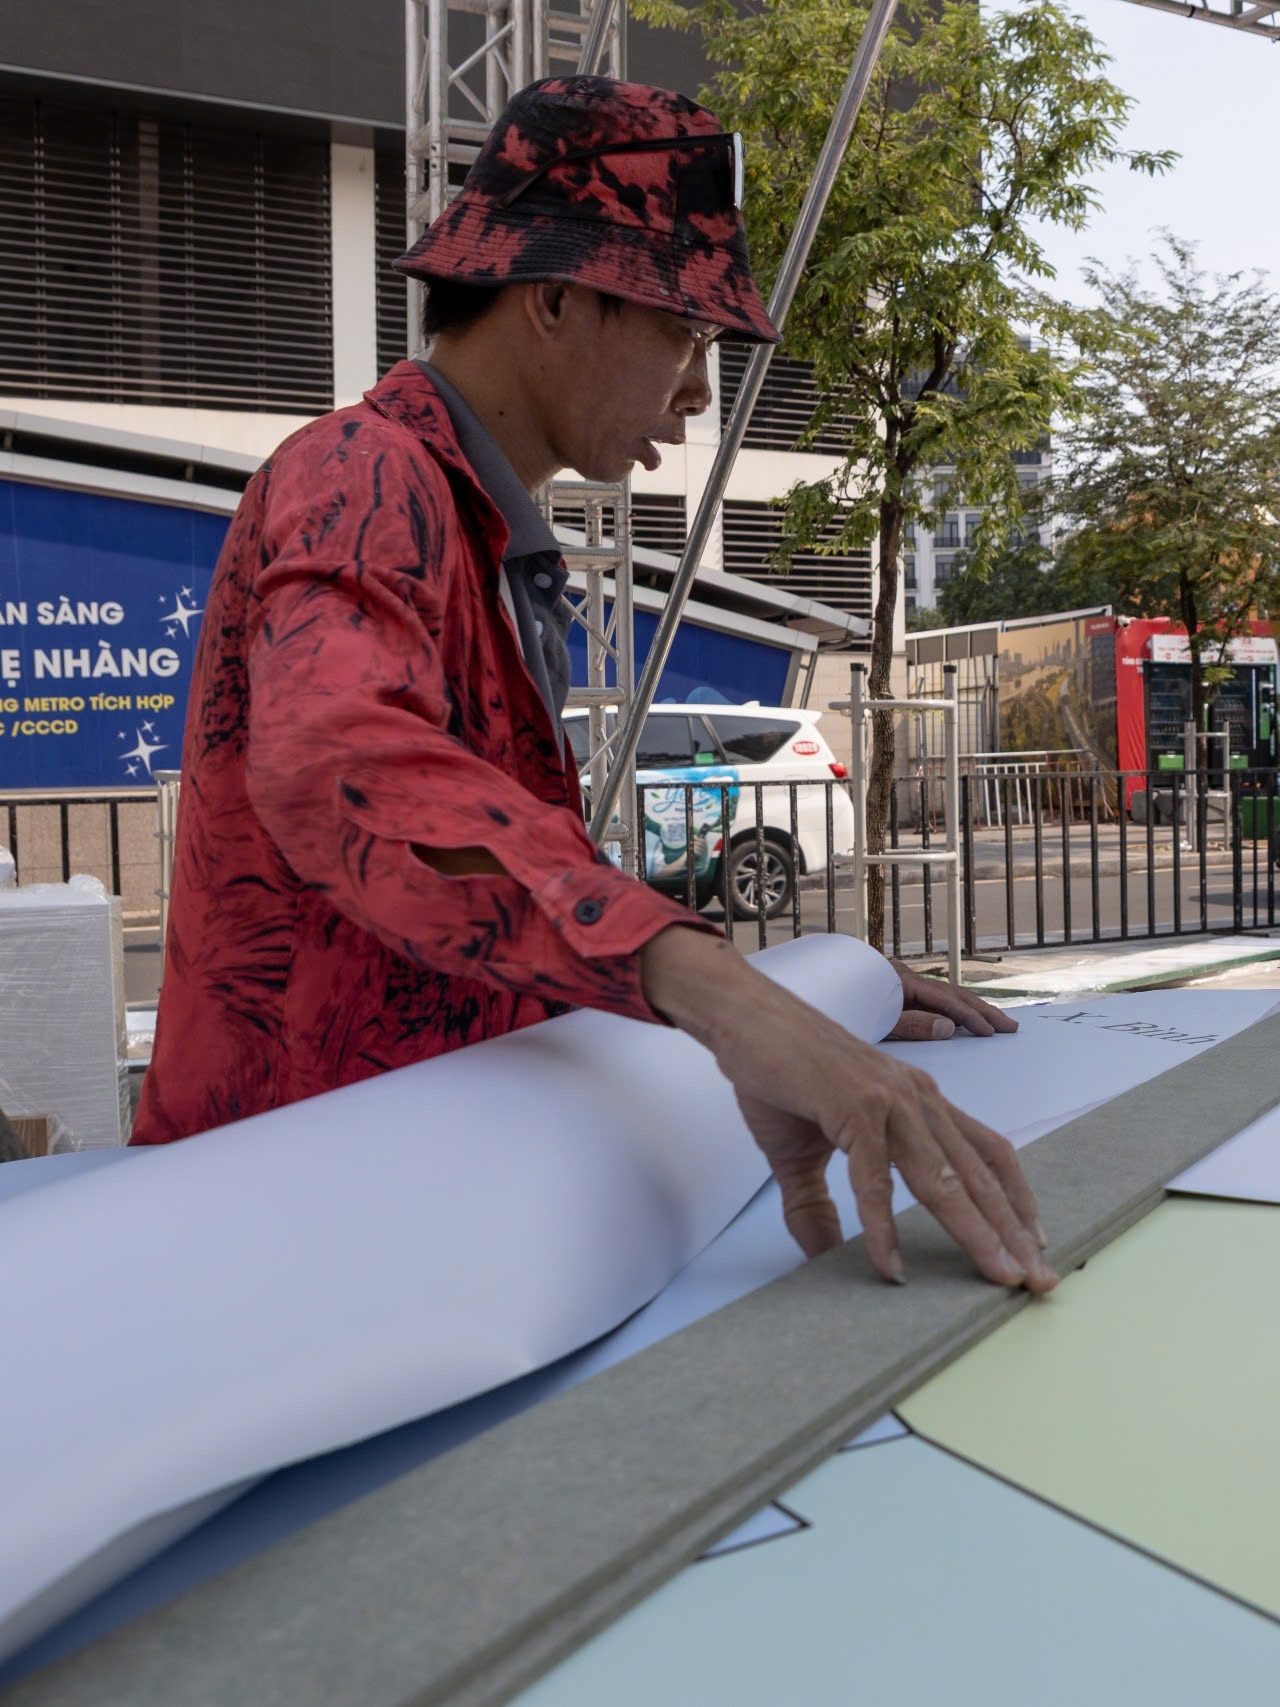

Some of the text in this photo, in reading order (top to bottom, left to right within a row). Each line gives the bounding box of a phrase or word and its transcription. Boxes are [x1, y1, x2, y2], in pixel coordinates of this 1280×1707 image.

[0, 595, 125, 626] N SÀNG
[34, 639, 181, 679] NHÀNG
[24, 696, 85, 712] METRO
[89, 692, 132, 711] TÍCH
[136, 693, 175, 713] HỢP
[11, 719, 79, 738] /CCCD
